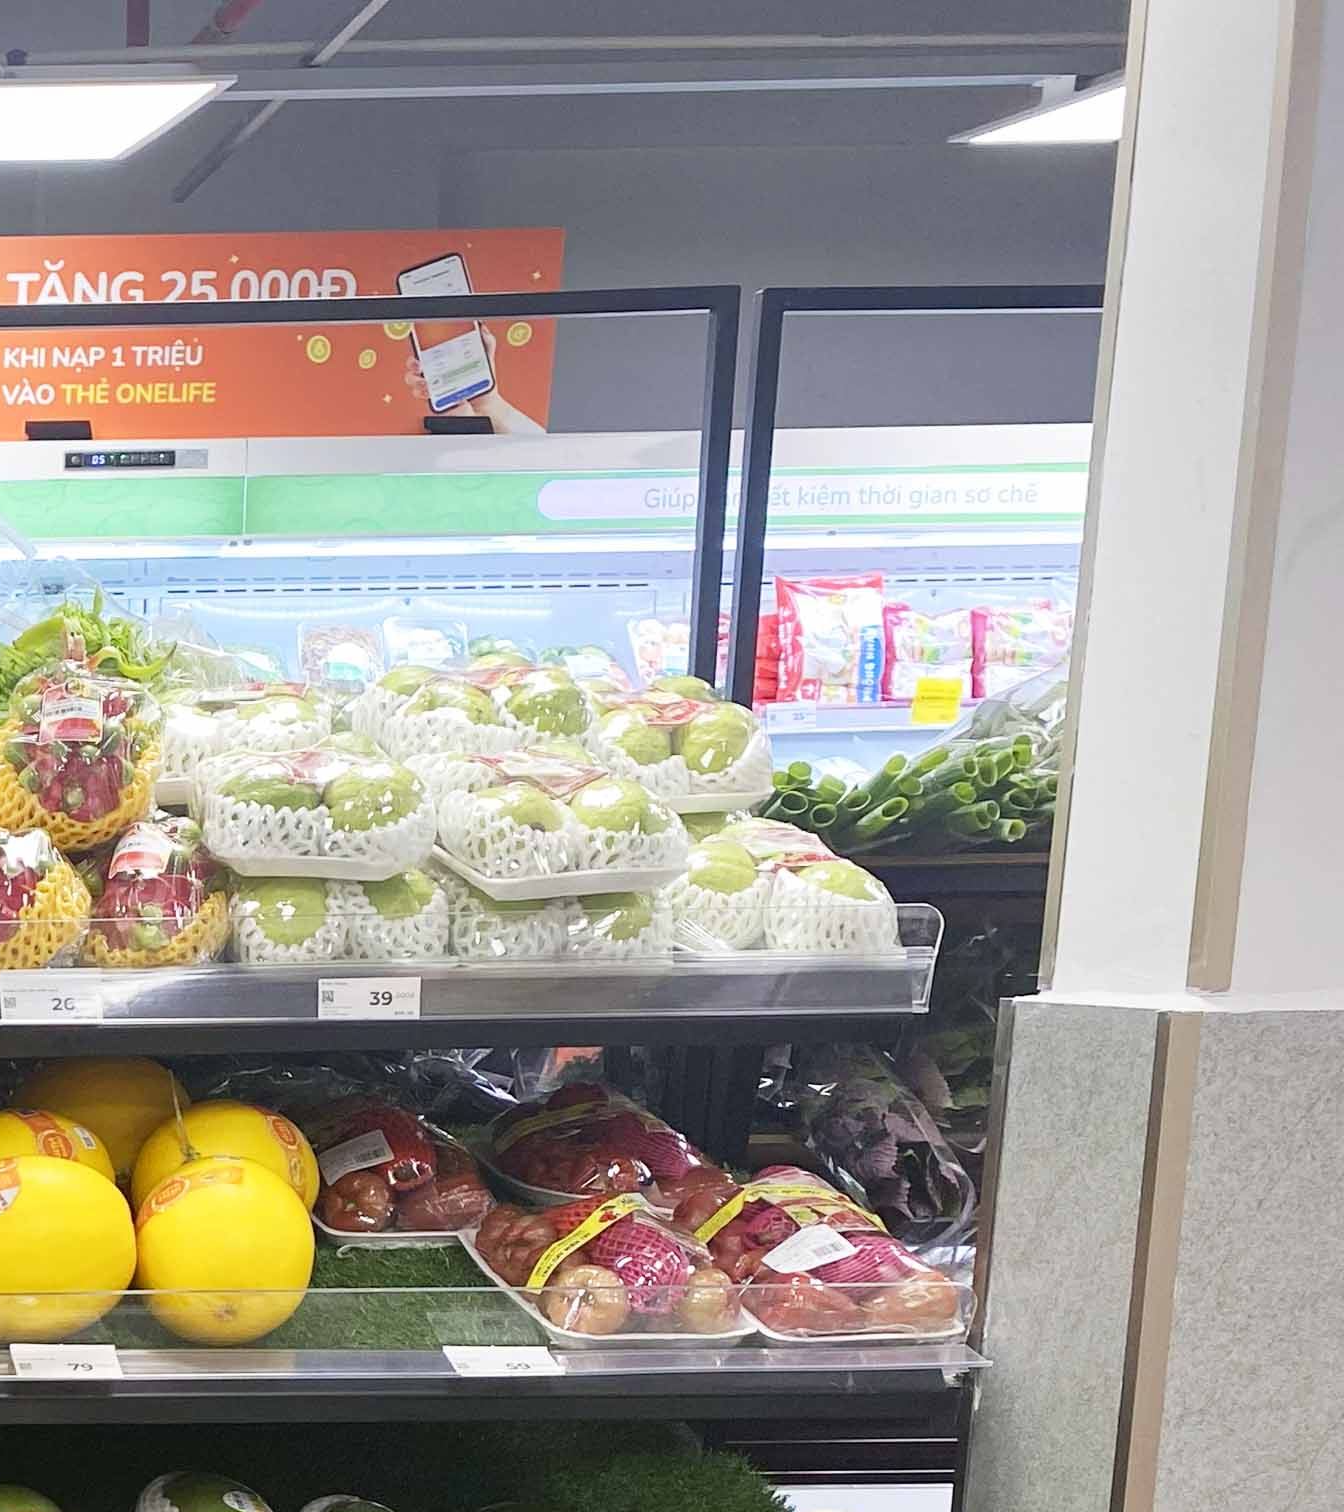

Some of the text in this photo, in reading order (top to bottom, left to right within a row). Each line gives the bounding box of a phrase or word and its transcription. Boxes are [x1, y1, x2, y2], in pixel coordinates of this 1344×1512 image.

[3, 340, 203, 373] KHI NẠP 1 TRIỆU
[2, 377, 216, 405] VÀO THẺ ONELIFE
[369, 991, 393, 1006] 39
